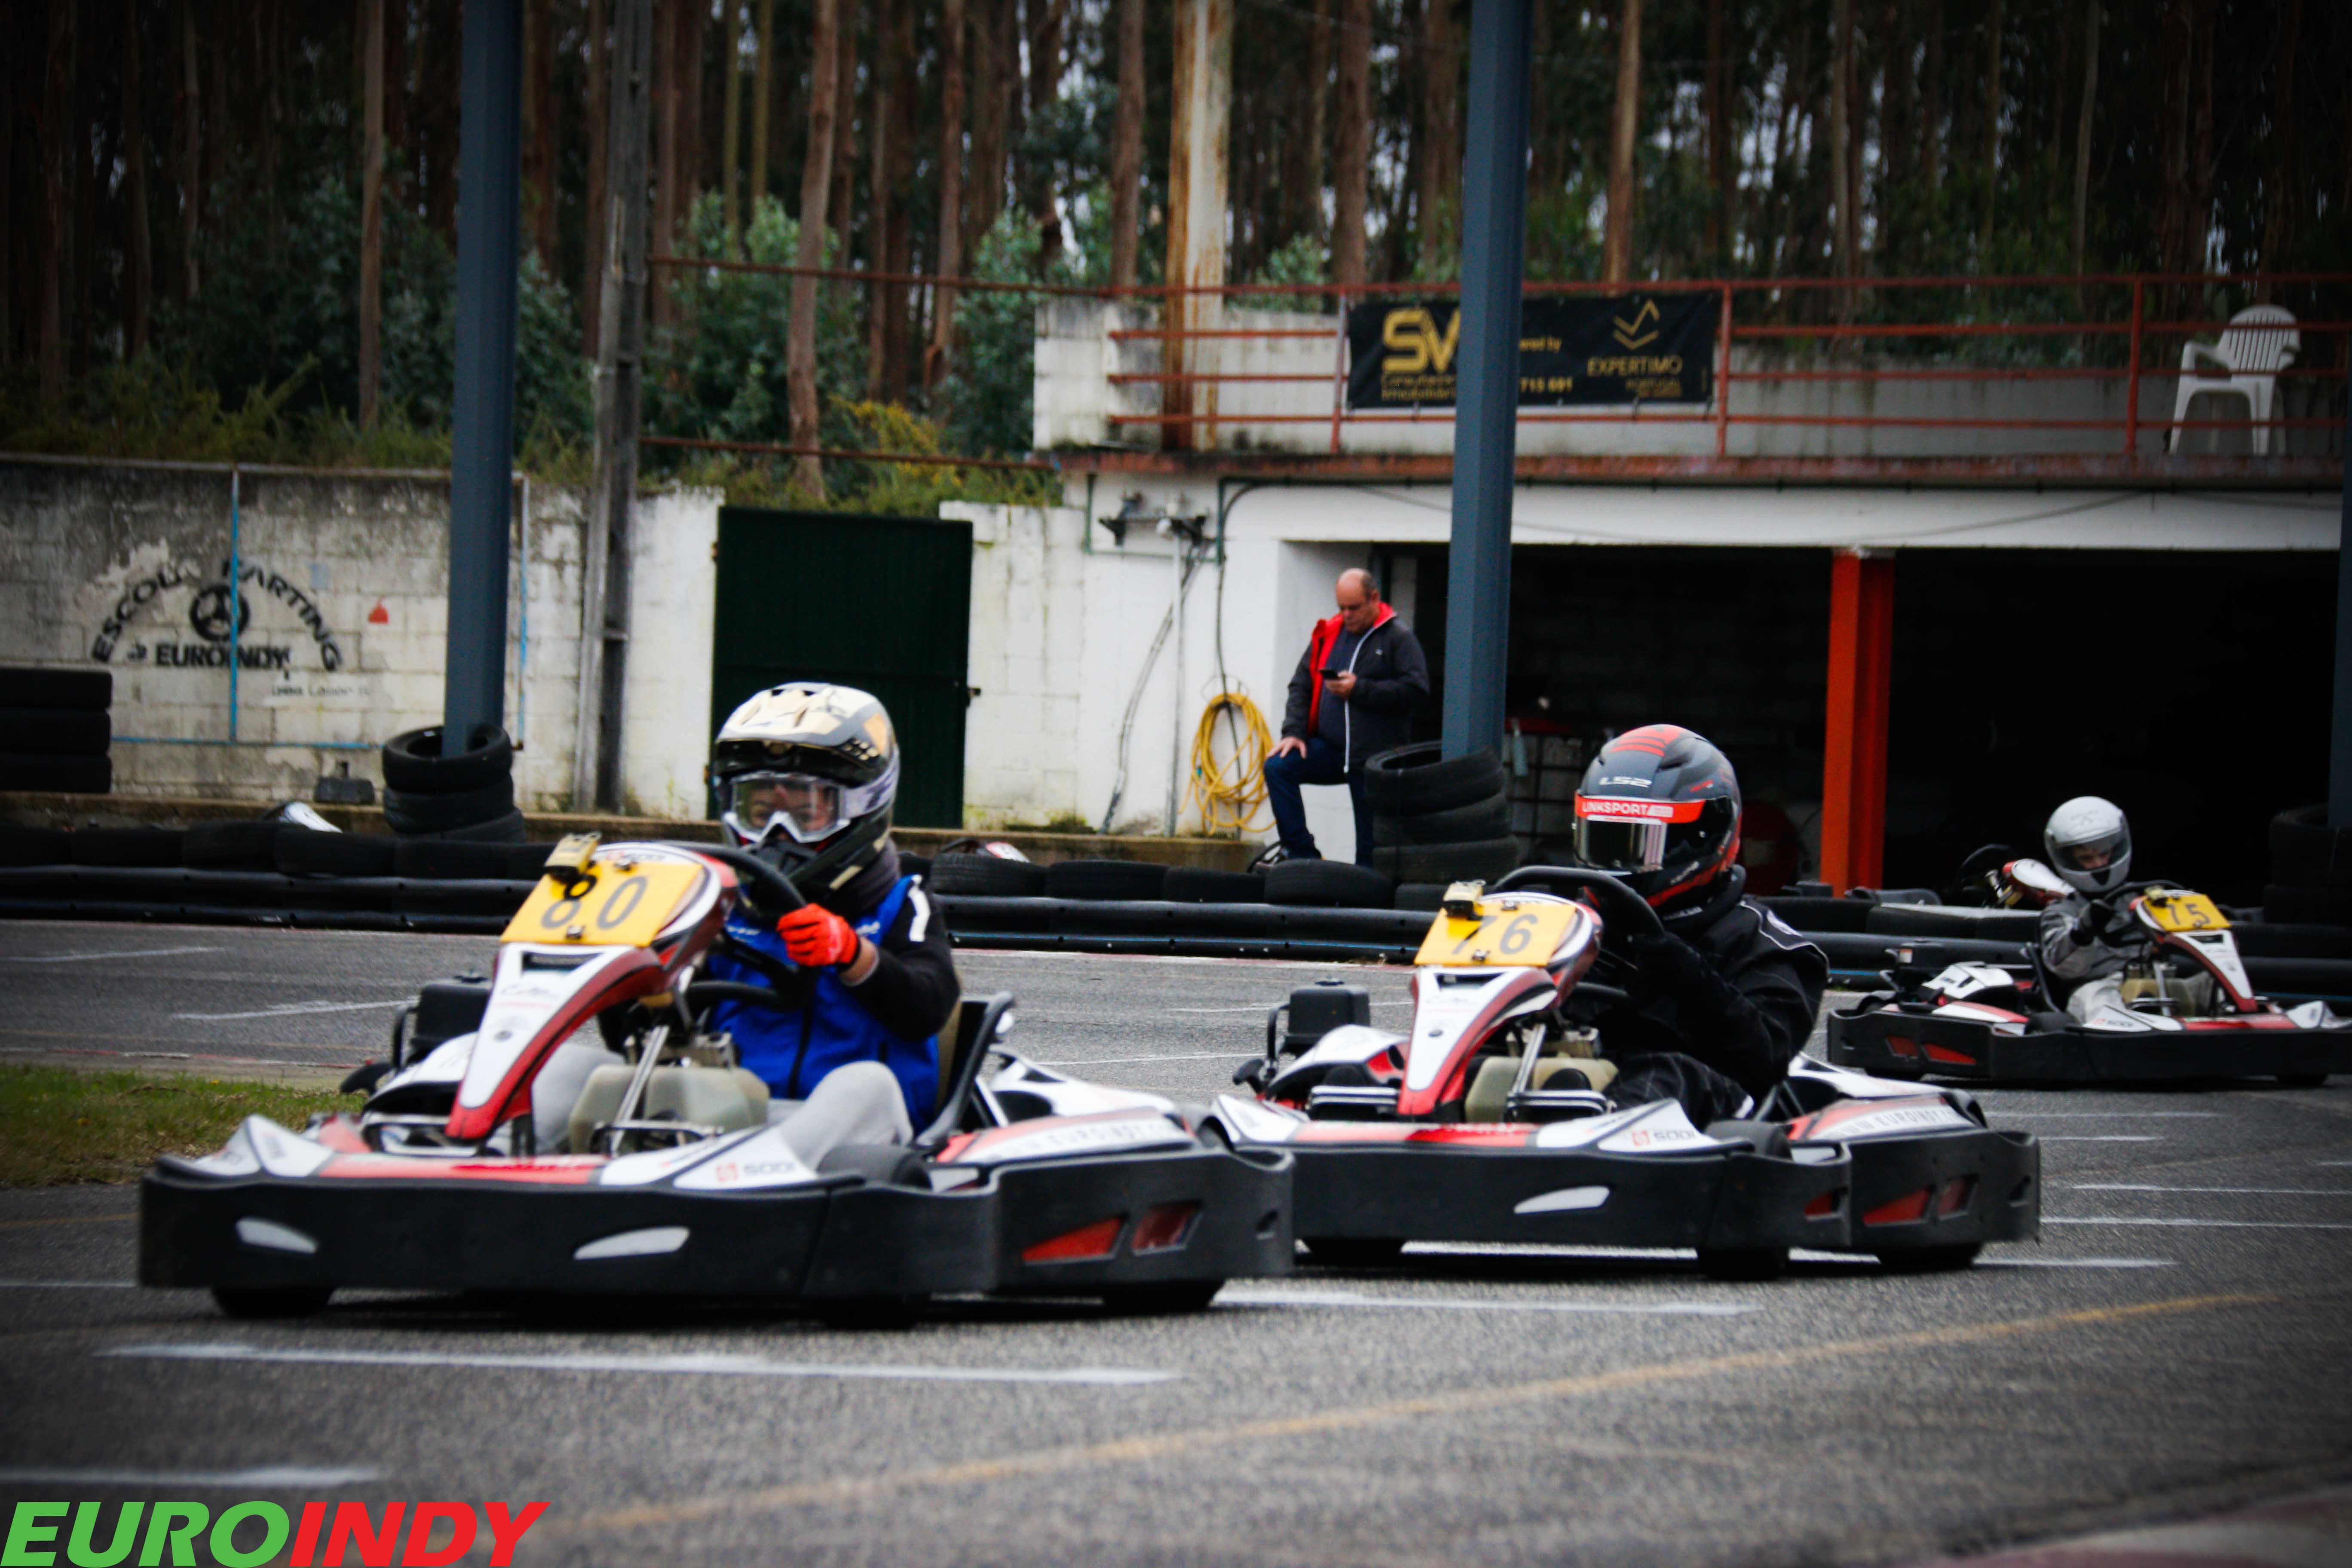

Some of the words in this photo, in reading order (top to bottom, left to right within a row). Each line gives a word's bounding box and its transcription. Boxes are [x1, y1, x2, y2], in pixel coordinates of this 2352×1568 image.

[1587, 355, 1683, 377] EXPERTIMO
[92, 560, 189, 663] ESCOL
[1599, 776, 1652, 788] LS2
[1582, 801, 1648, 816] LINKSPORT
[1452, 914, 1538, 954] 76
